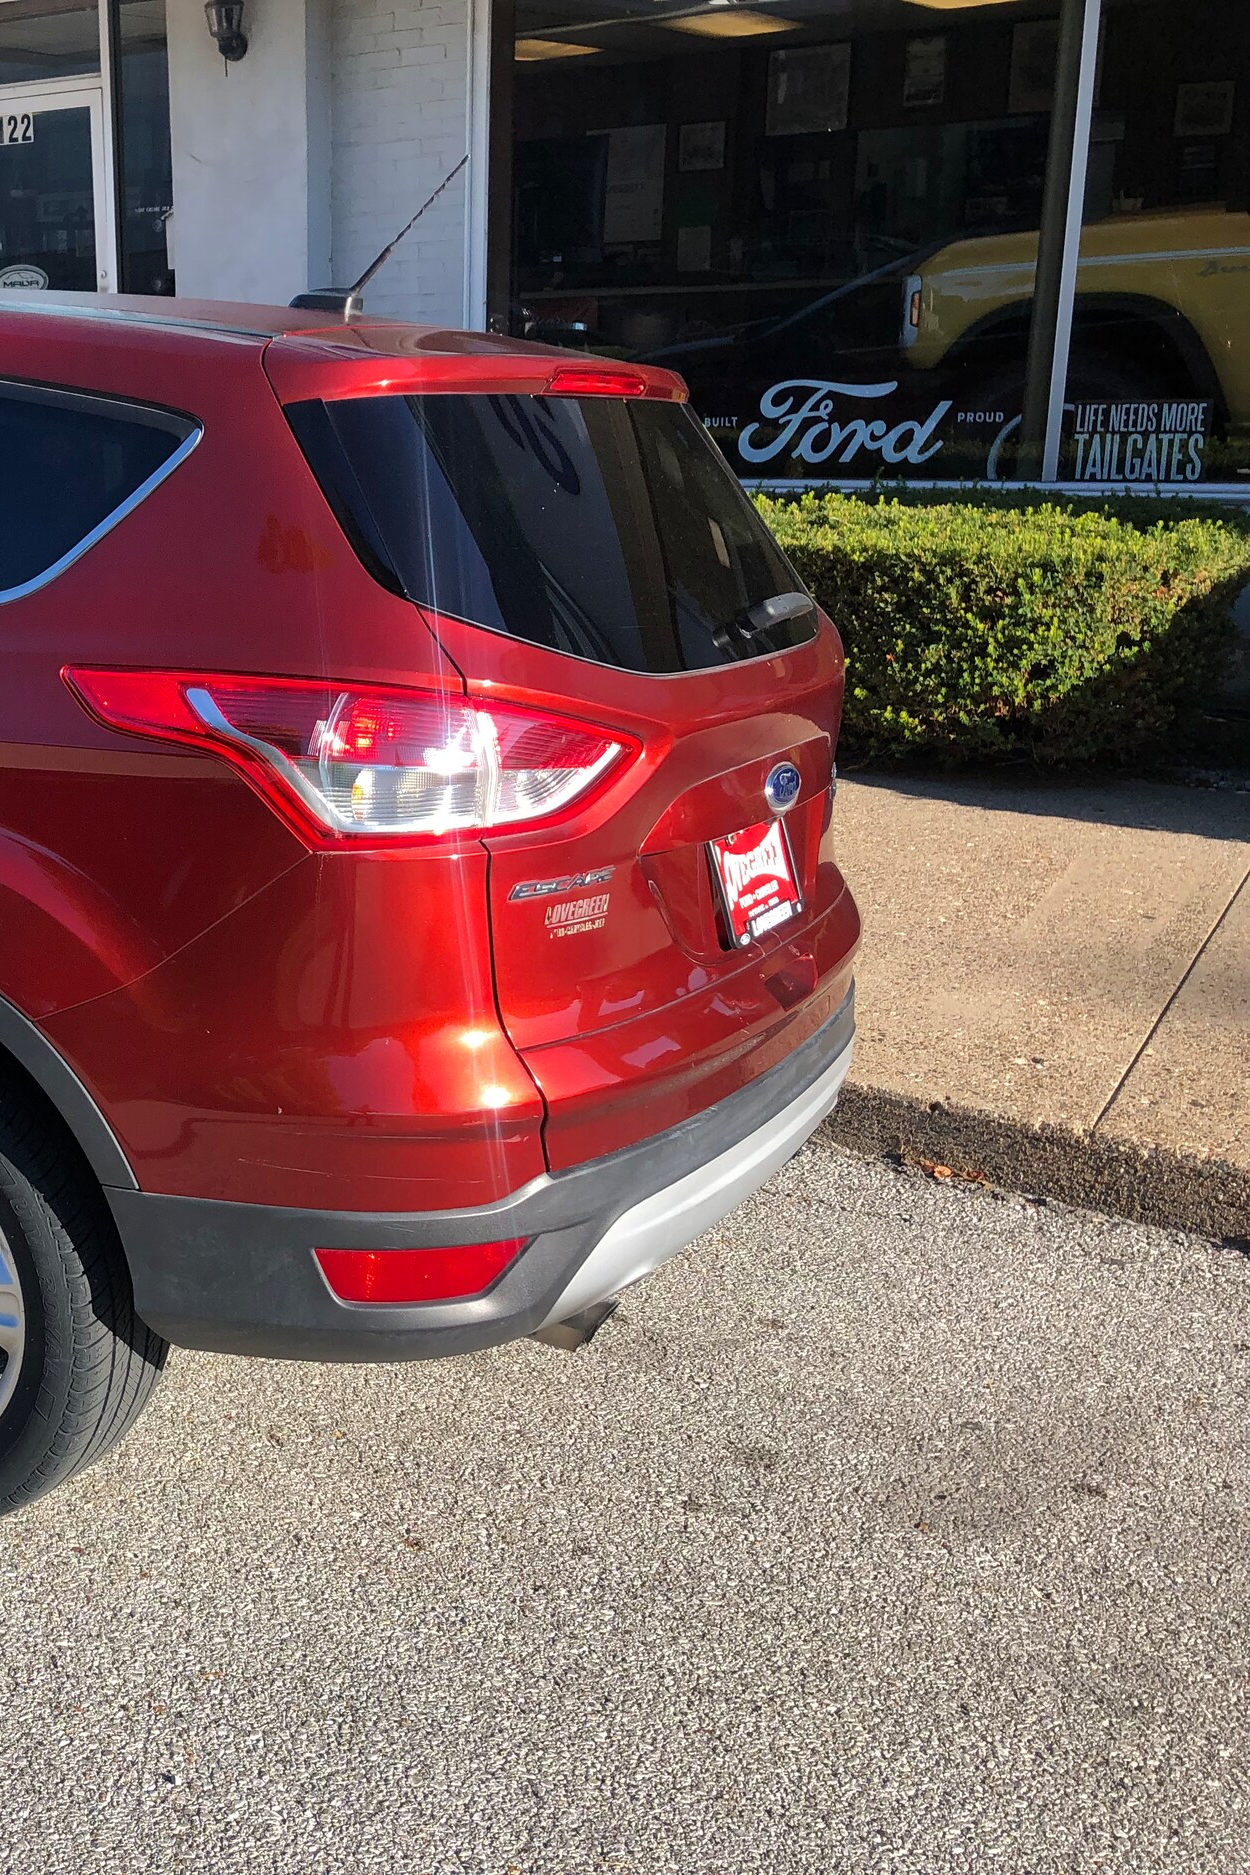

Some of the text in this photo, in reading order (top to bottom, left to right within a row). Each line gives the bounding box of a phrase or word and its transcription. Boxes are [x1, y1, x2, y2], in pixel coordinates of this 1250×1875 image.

[704, 379, 1005, 465] BUILT Ford PROUD
[1075, 402, 1208, 432] LIFE NEEDS MORE
[1073, 433, 1205, 481] TAILGATES
[507, 865, 616, 902] ESCAPE
[544, 893, 610, 926] LOVEGREEN
